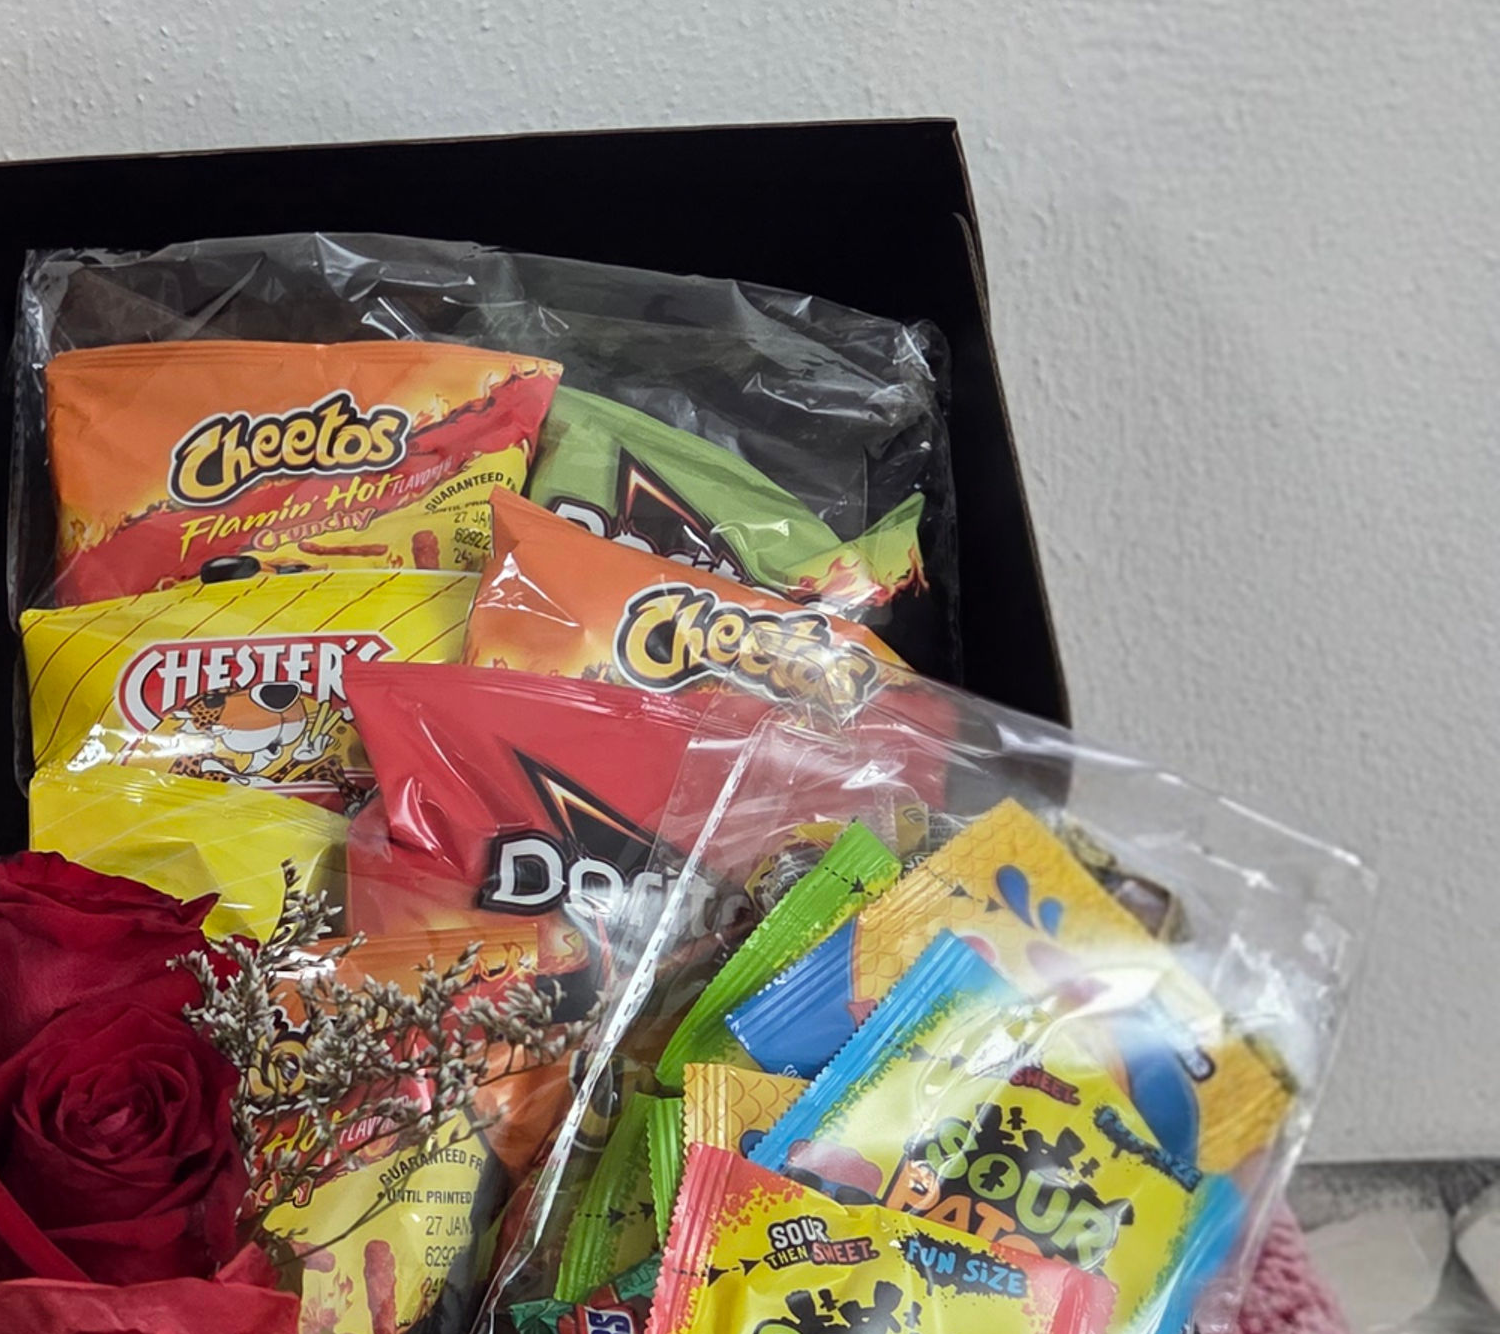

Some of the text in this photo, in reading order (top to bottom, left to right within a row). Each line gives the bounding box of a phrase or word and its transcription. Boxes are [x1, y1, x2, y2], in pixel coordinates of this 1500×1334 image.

[177, 399, 401, 500] Cheetos
[424, 471, 504, 512] GUARANTEED
[180, 494, 318, 563] Flamin'
[323, 472, 404, 511] Hot
[251, 507, 379, 552] Crunchy
[379, 1147, 467, 1186] GUARANTEED
[426, 1190, 472, 1205] PRINTED
[925, 1122, 1115, 1269] SOUR
[425, 1215, 443, 1236] 27
[771, 1218, 829, 1249] SOUR
[766, 1244, 809, 1268] THEN
[907, 1238, 956, 1274] FUN
